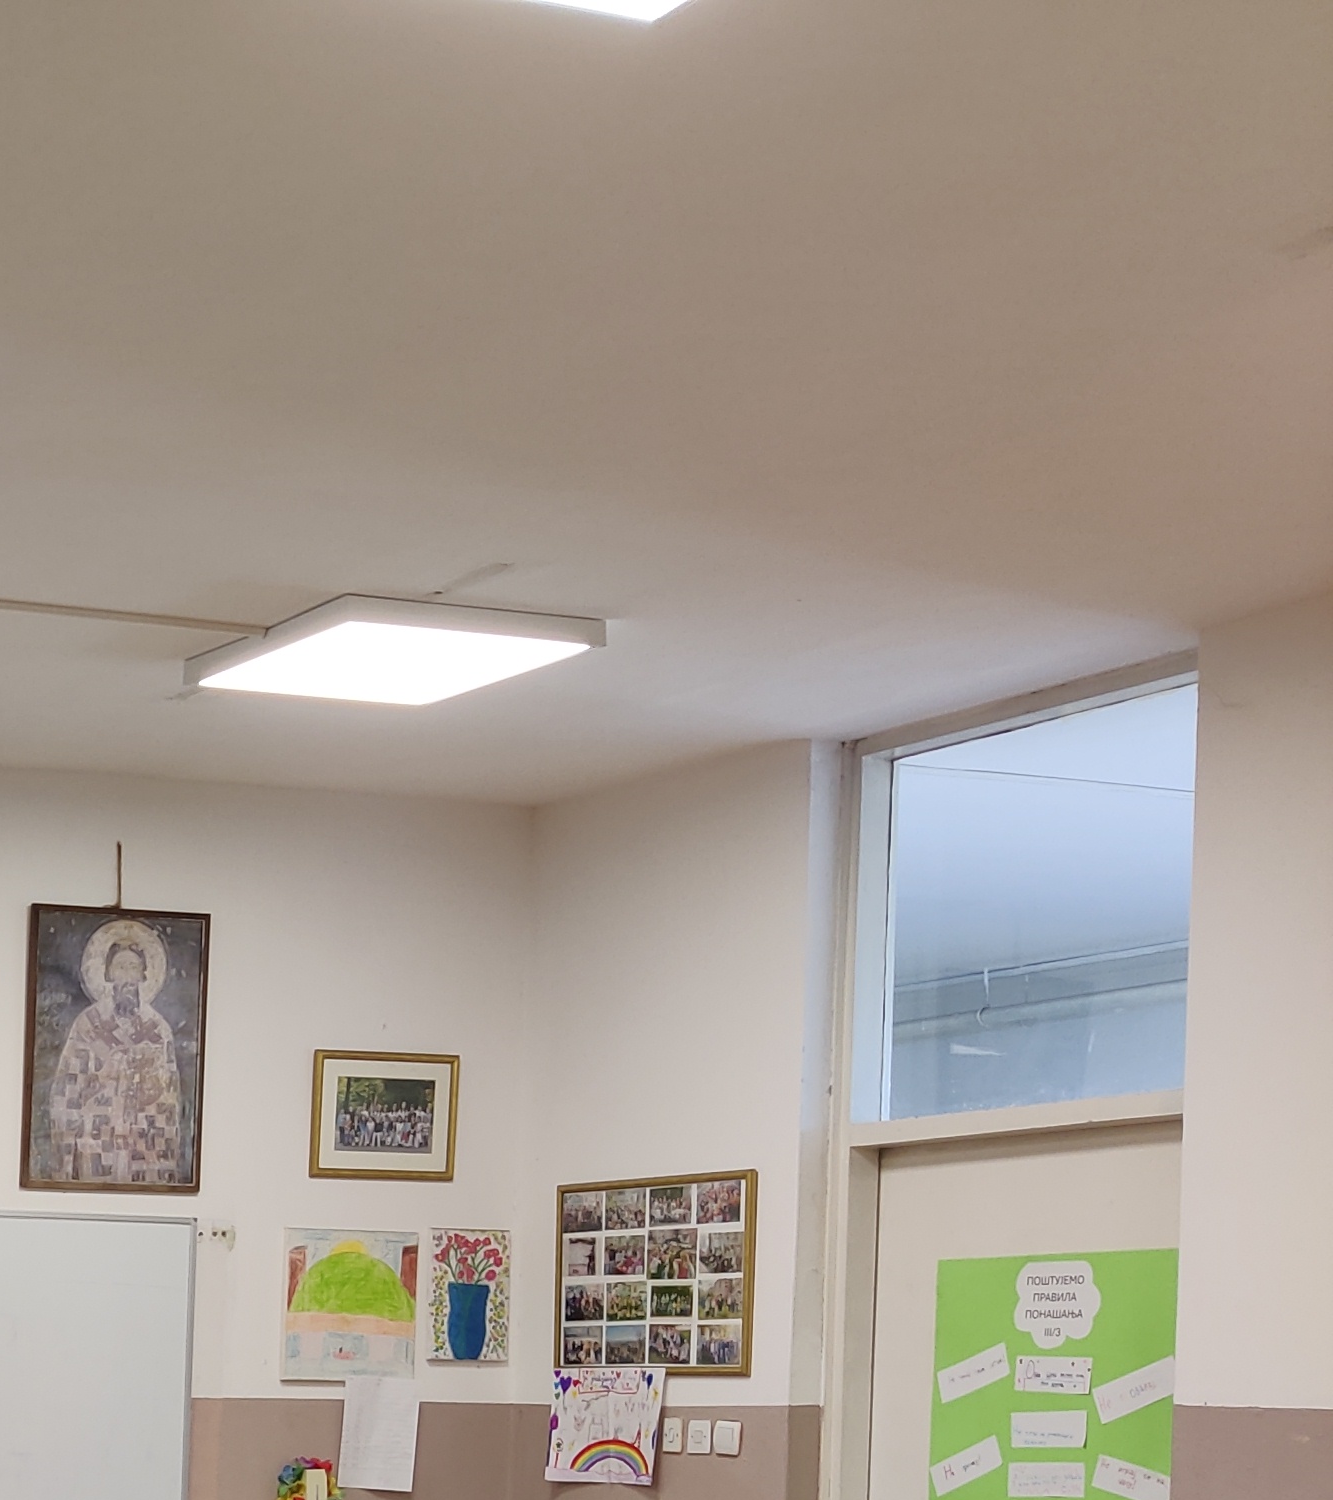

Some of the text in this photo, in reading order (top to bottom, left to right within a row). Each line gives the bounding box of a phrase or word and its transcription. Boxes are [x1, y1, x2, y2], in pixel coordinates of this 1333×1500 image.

[1026, 1275, 1085, 1286] ПОШТУЈЕМО
[1033, 1292, 1077, 1302] ПРАВИЛА
[1025, 1309, 1083, 1319] ПОНАШАЊА
